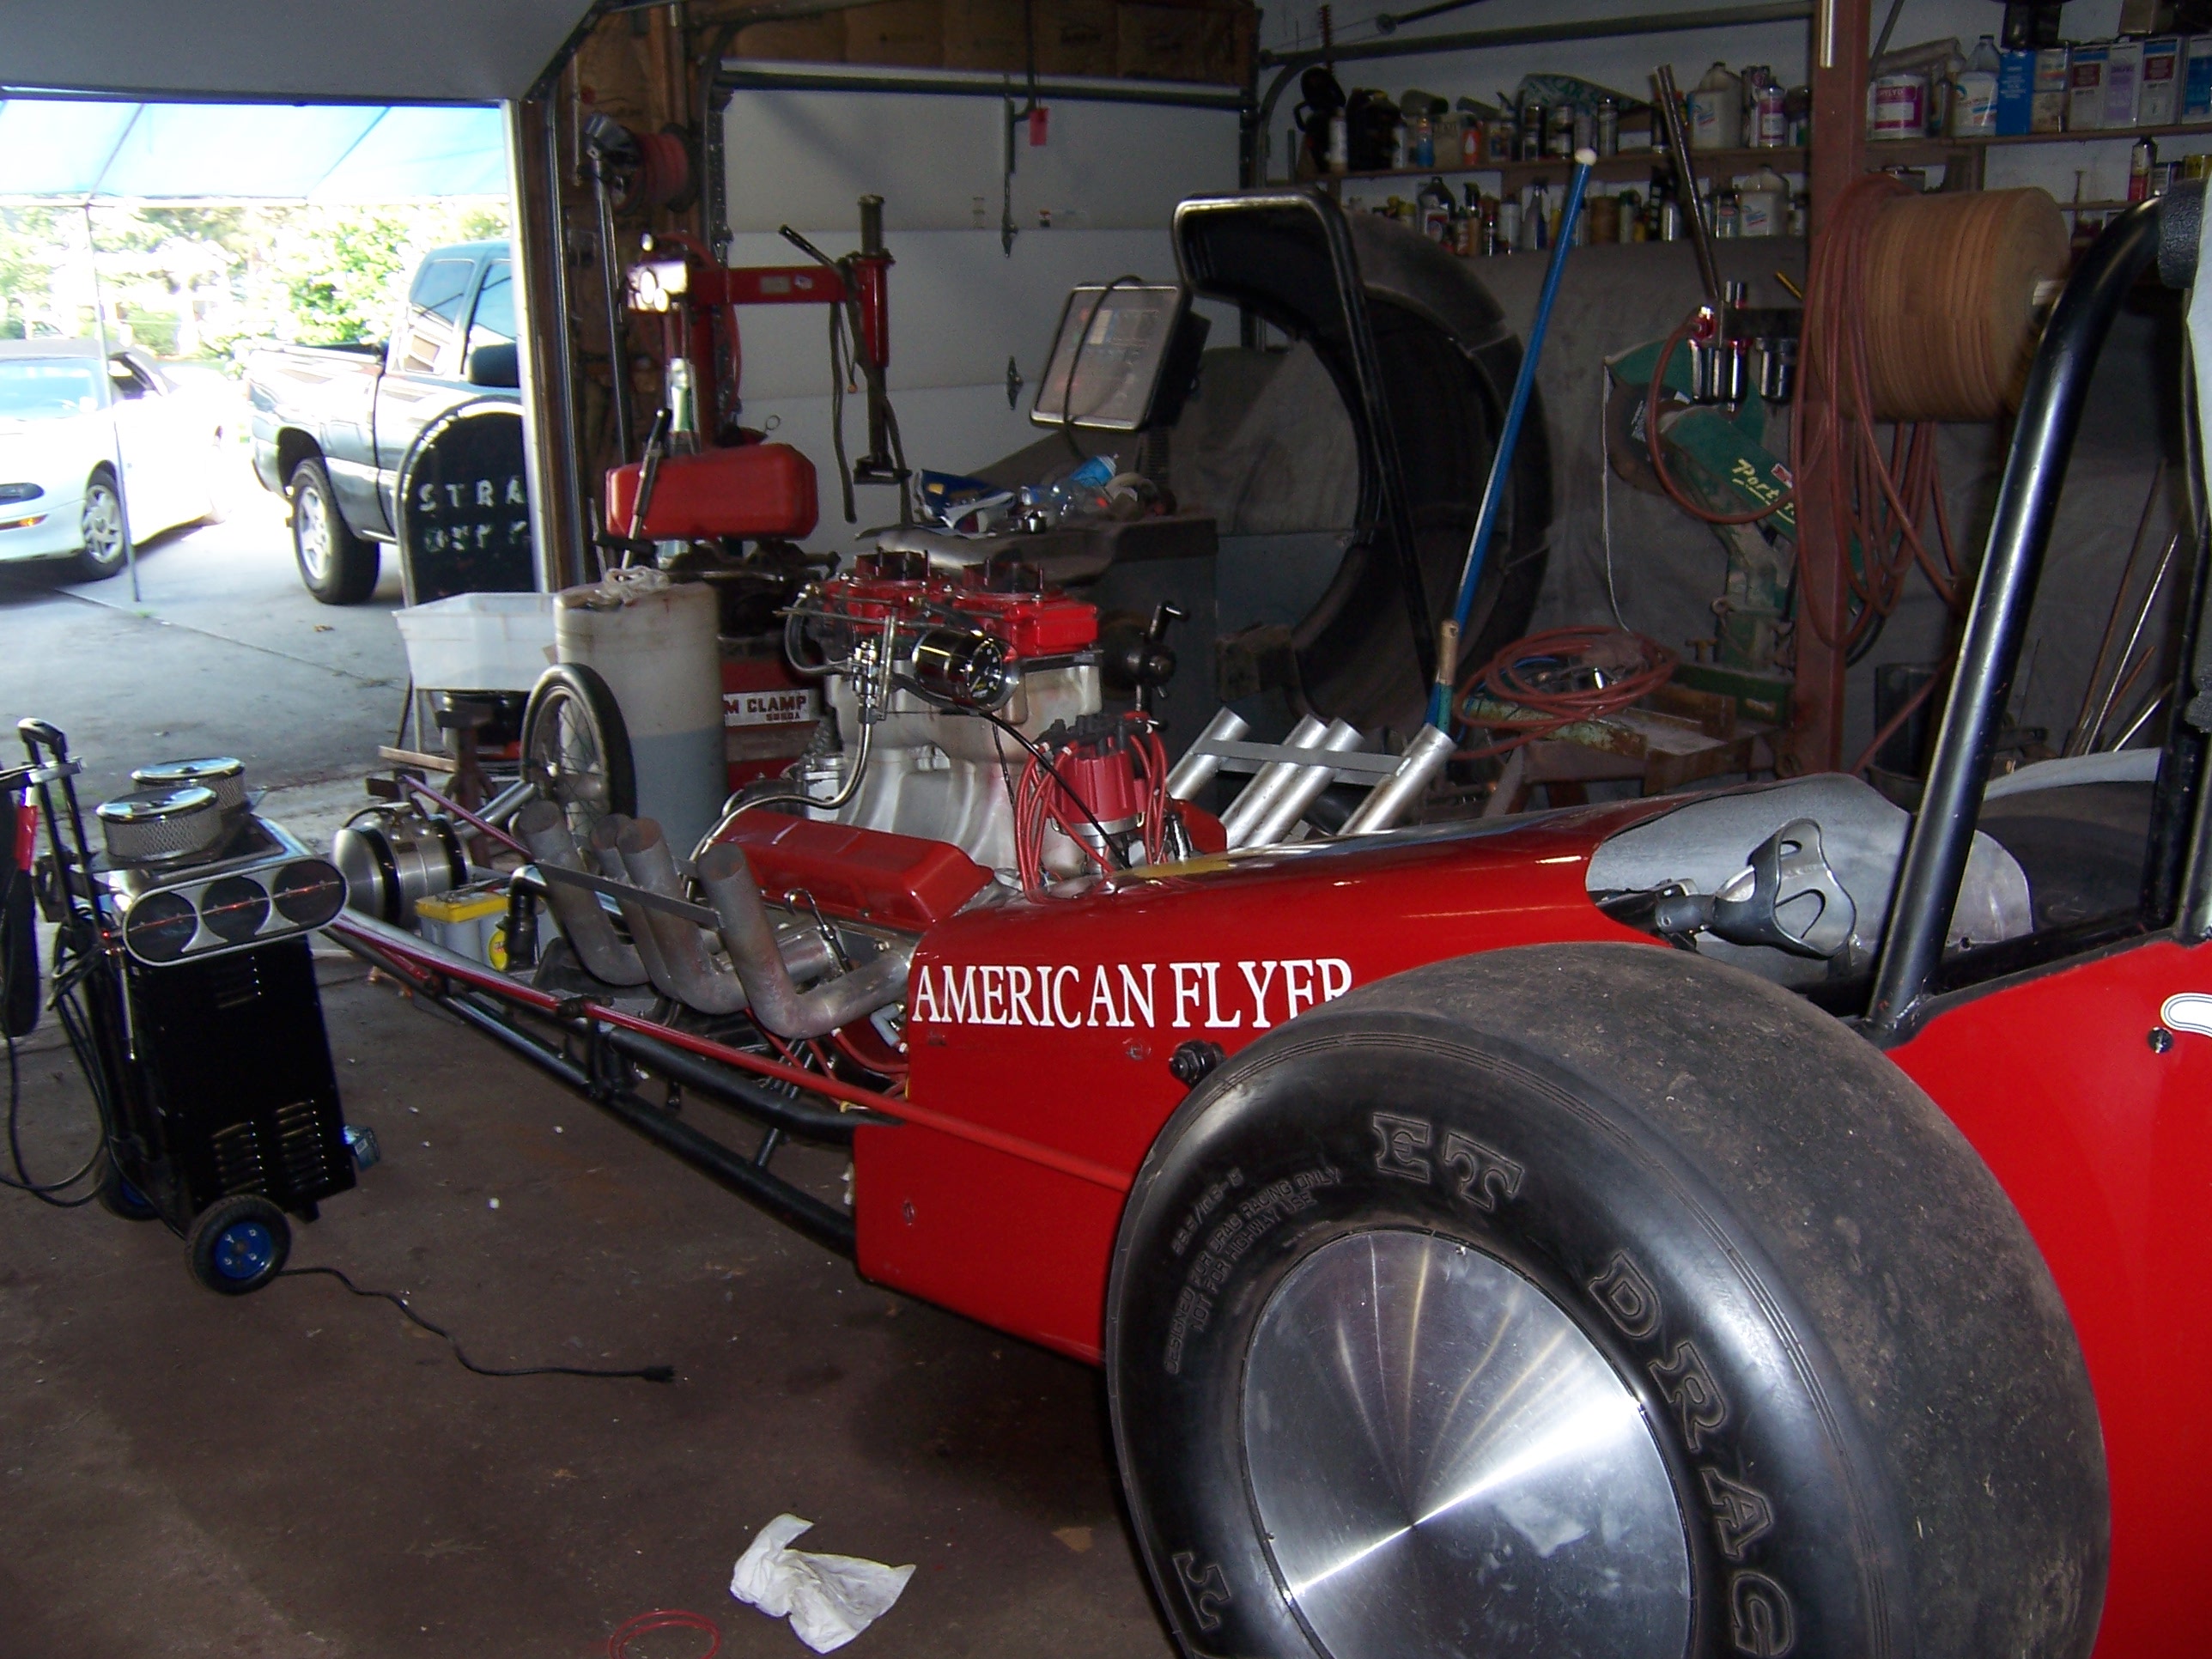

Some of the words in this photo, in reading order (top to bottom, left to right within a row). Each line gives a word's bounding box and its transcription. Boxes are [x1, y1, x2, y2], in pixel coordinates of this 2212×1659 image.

[746, 696, 806, 713] CLAMP
[911, 963, 1156, 1029] AMERICAN
[1242, 1178, 1292, 1218] RACING
[1295, 1165, 1341, 1190] ONLY
[1373, 1113, 1523, 1211] ET
[1225, 1208, 1282, 1261] HIGHWAY
[1284, 1190, 1318, 1213] USE
[1589, 1251, 1795, 1659] DRAG
